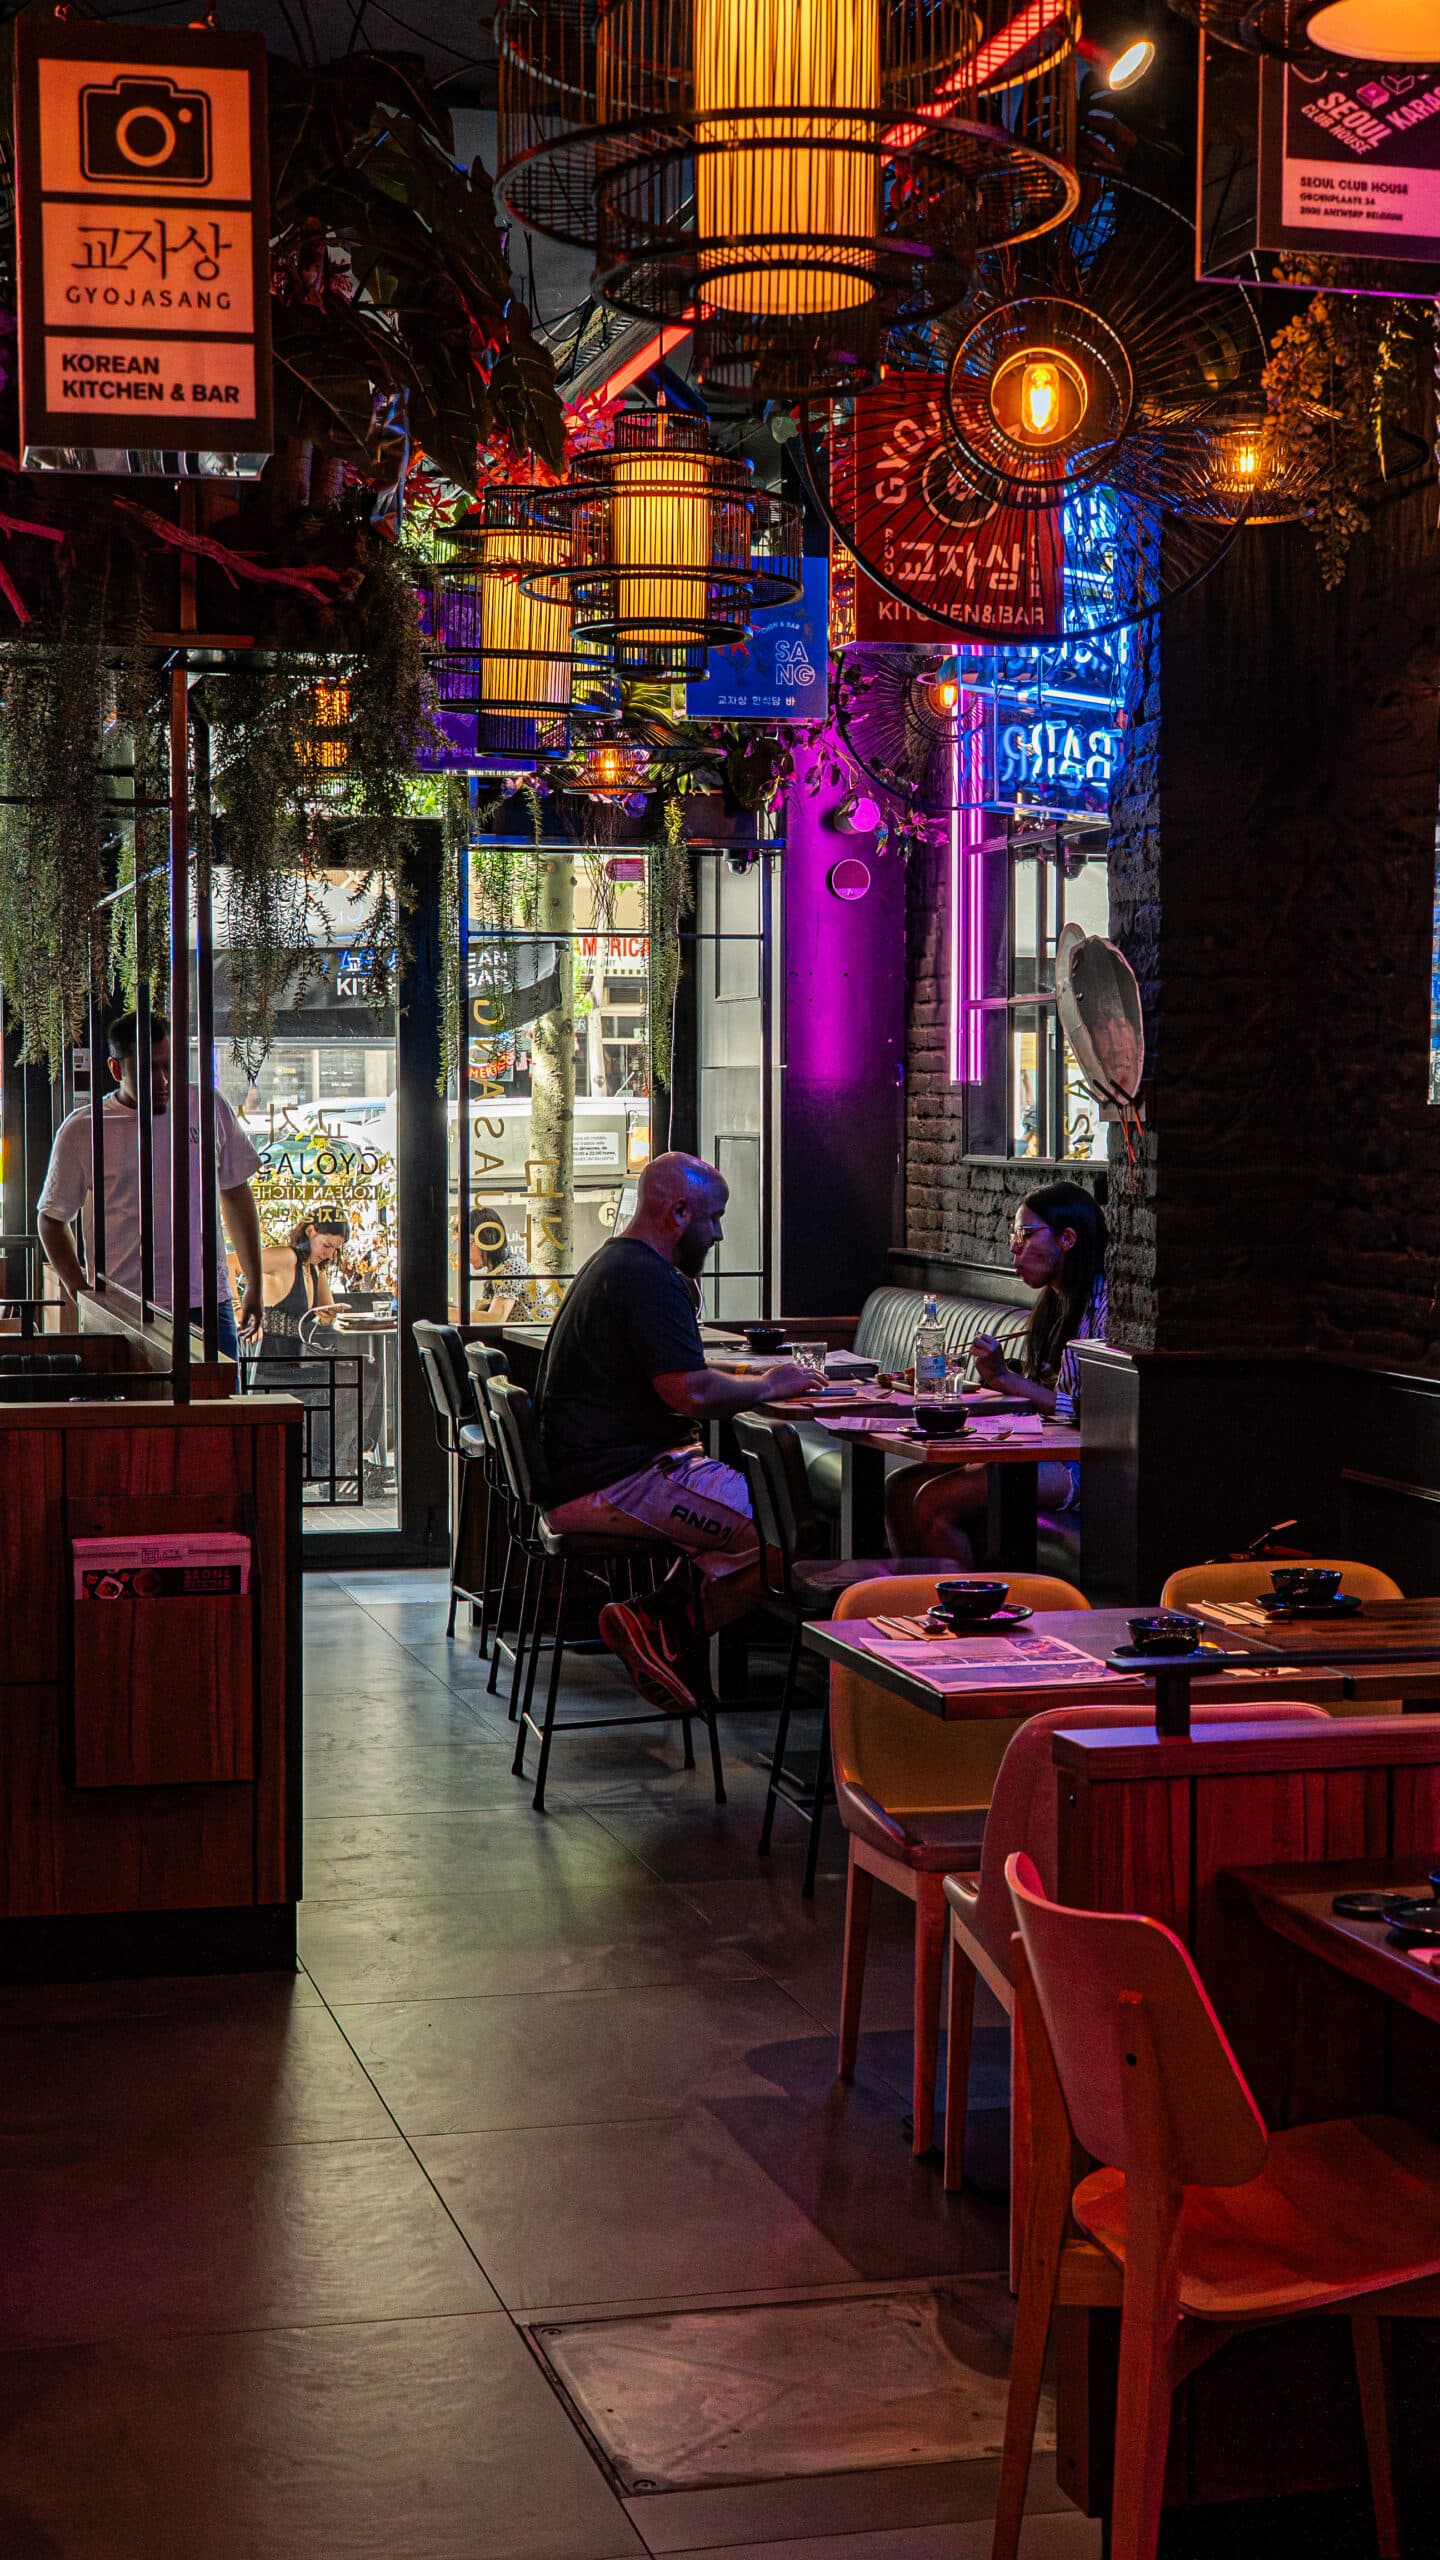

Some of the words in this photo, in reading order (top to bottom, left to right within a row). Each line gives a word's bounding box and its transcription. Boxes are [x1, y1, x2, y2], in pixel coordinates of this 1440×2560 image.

[1301, 103, 1335, 128] CLUB
[1328, 124, 1372, 155] HOUSE
[1317, 91, 1392, 148] SEOUL
[1300, 176, 1334, 188] SEOUL
[1338, 180, 1368, 192] CLUB
[1371, 183, 1408, 195] HOUSE
[1323, 208, 1363, 218] ANTWERP
[1365, 212, 1403, 222] BELGIUM
[71, 218, 232, 281] 교자상
[66, 285, 231, 310] GYOJASANG
[62, 354, 160, 375] KOREAN
[62, 380, 164, 401] KITCHEN
[170, 383, 185, 402] &
[192, 384, 240, 403] BAR
[775, 641, 808, 662] SA
[775, 664, 815, 687] NG
